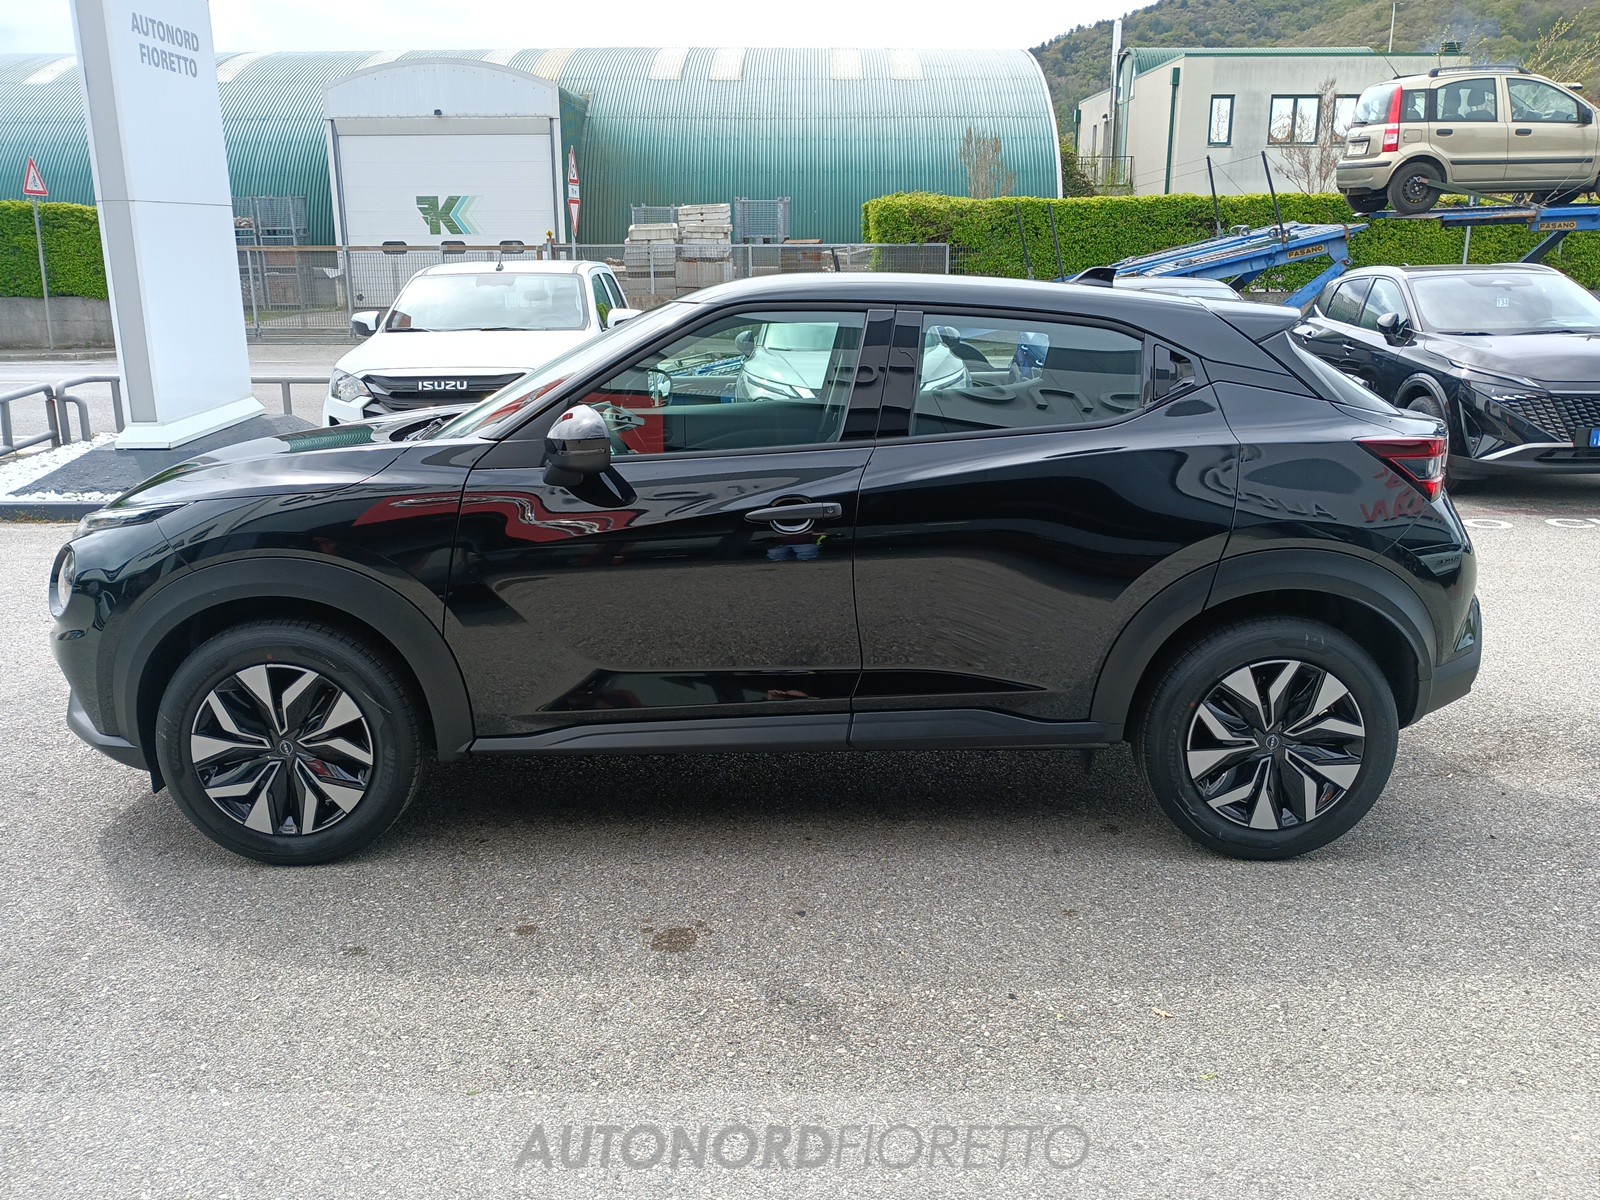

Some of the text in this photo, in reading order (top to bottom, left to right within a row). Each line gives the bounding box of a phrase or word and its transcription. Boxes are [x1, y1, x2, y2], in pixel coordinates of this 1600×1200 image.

[131, 12, 199, 52] AUTONORD
[139, 42, 198, 78] FIORETTO
[1540, 221, 1576, 229] FASANO
[1288, 245, 1323, 258] FASANO
[418, 380, 468, 391] ISUZU
